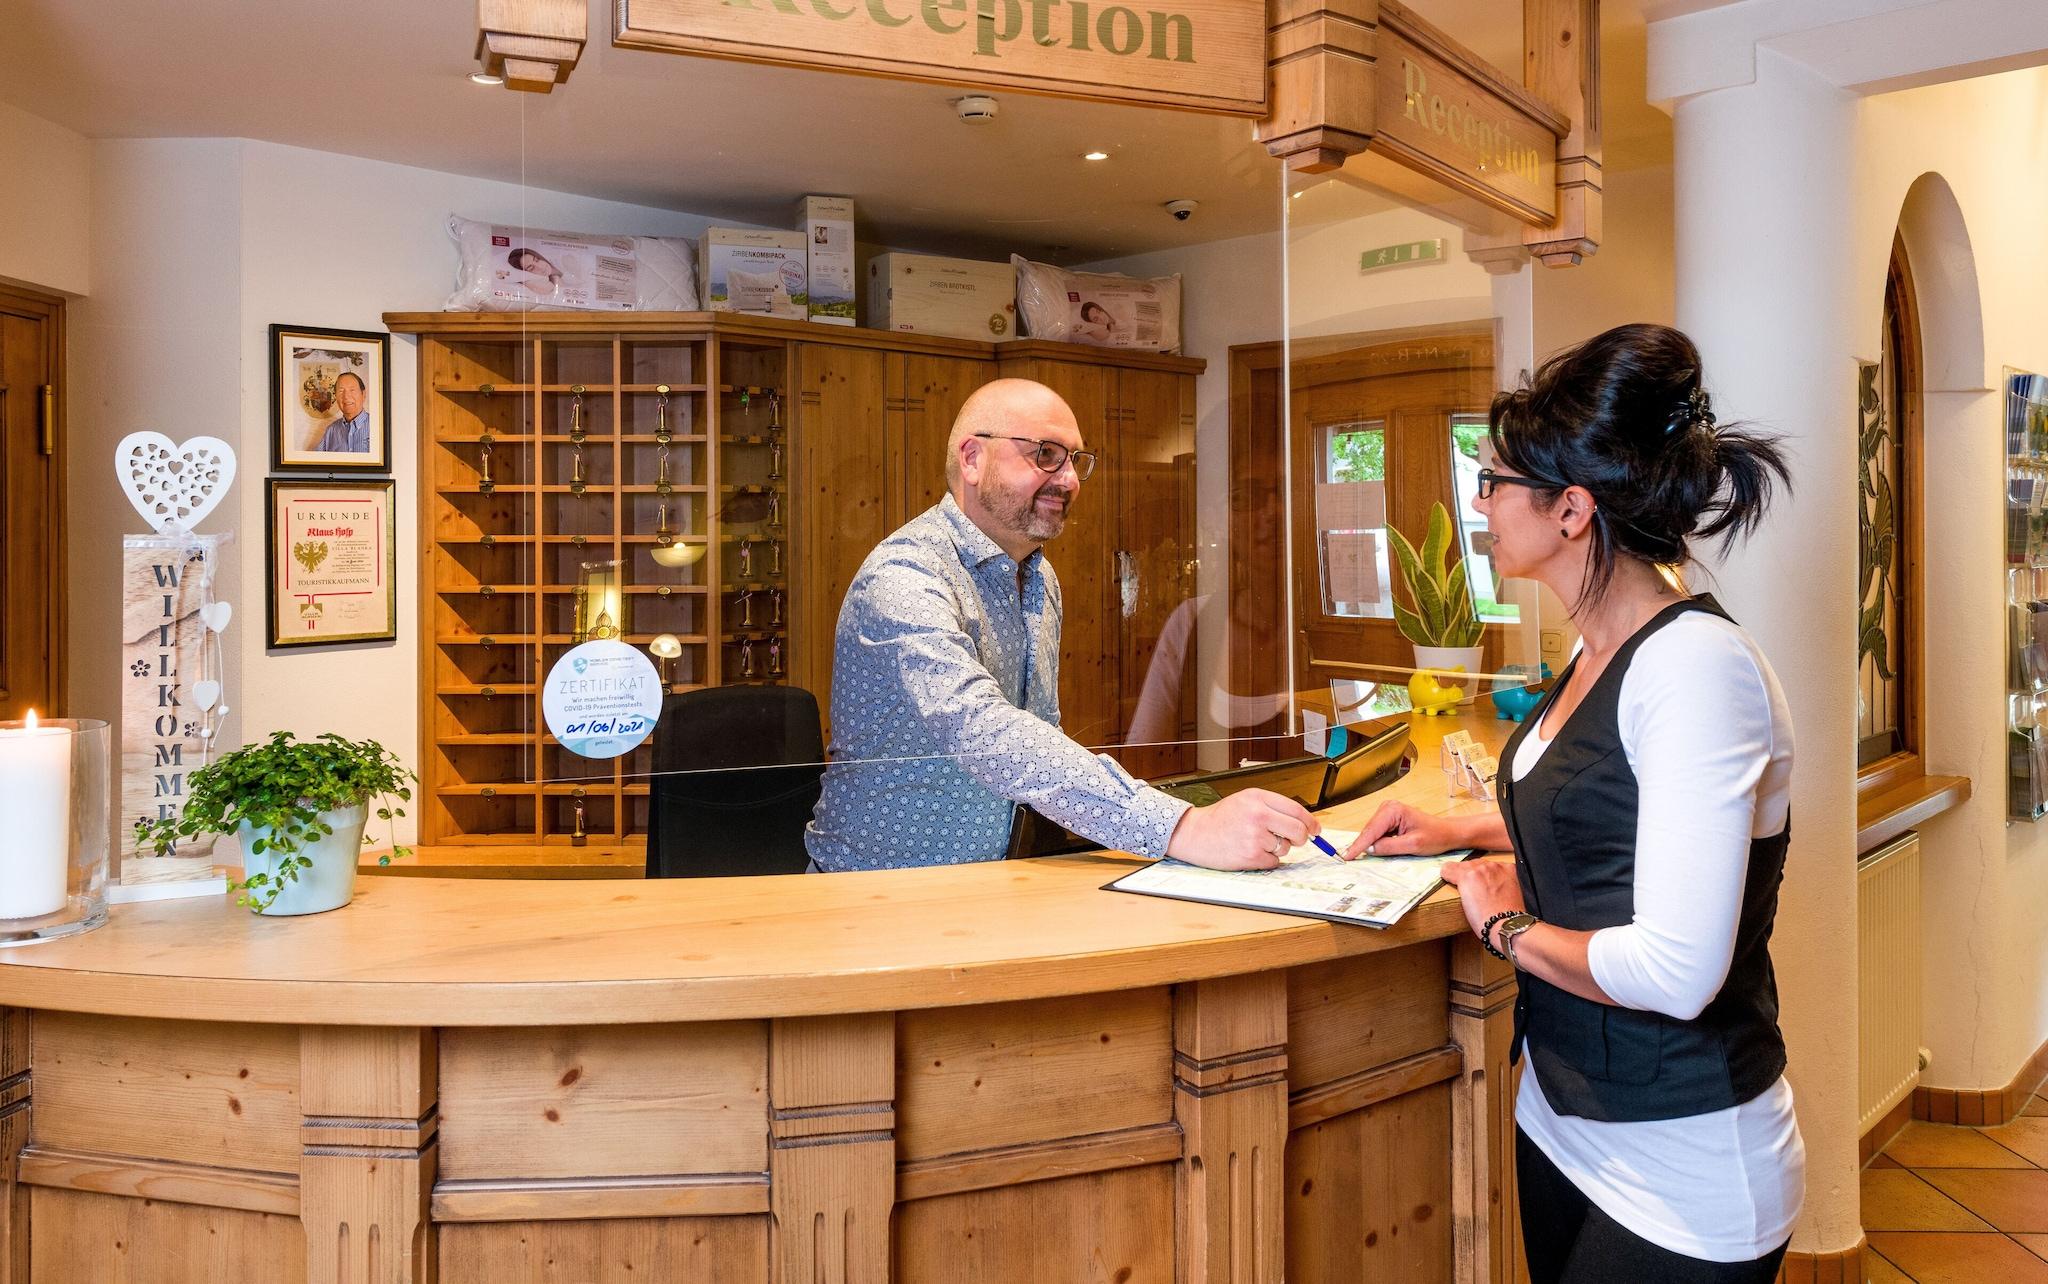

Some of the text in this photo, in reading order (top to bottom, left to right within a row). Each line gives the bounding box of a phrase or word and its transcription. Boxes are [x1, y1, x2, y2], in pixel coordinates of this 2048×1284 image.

[722, 0, 1197, 63] ception
[1403, 57, 1539, 185] Reception
[731, 250, 786, 259] ZIRBENKOMBIPACK
[297, 512, 370, 521] URKUNDE
[297, 578, 370, 586] TOURISTIKKAUFMANN
[560, 677, 645, 694] ZERTIFIKAT
[584, 695, 607, 703] machen
[608, 693, 635, 701] freiwillig
[592, 702, 642, 710] Präventionstests
